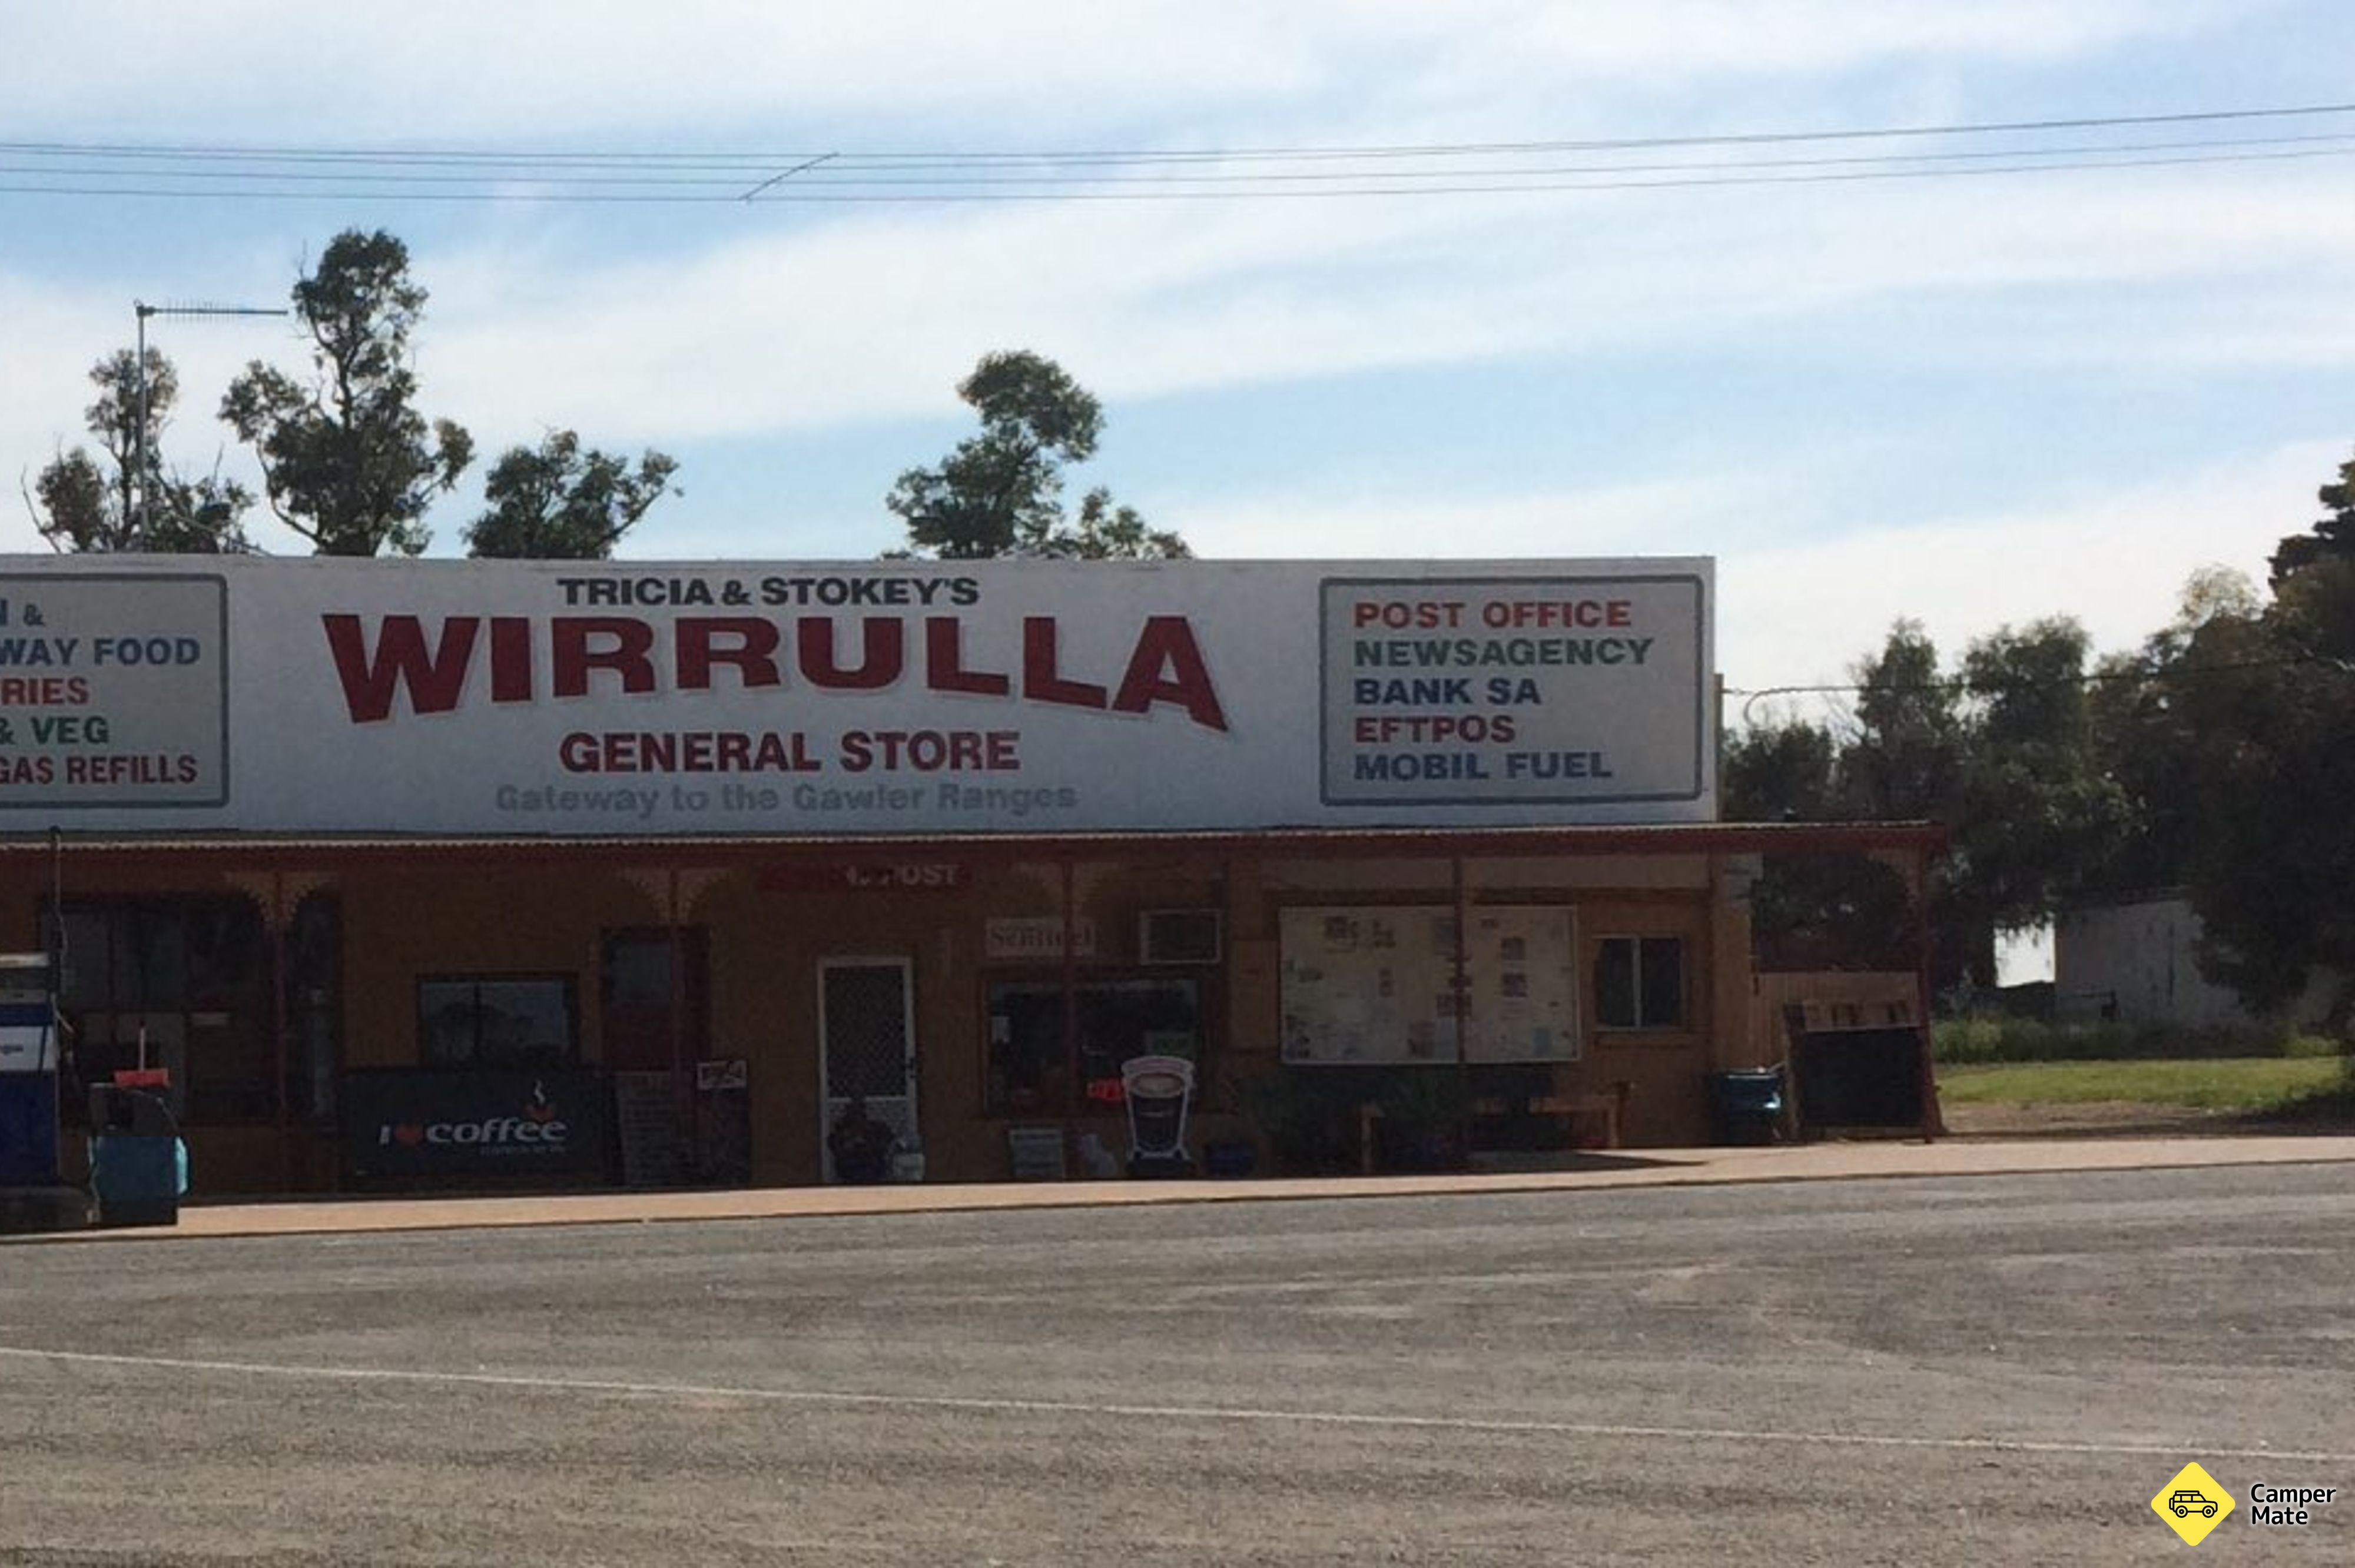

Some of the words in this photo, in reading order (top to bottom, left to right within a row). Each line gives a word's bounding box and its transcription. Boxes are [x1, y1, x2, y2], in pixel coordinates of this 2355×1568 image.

[557, 579, 714, 606] TRICIA
[722, 581, 751, 605] &
[761, 577, 979, 606] STOKEY'S
[23, 604, 44, 626] &
[1355, 602, 1464, 628] POST
[1483, 601, 1631, 628] OFFICE
[94, 638, 201, 665] FOOD
[1355, 639, 1653, 666] NEWSAGENCY
[321, 614, 1228, 732] WIRRULLA
[1355, 679, 1472, 705] BANK
[1487, 678, 1541, 705] SA
[31, 716, 110, 745] VEG
[1355, 716, 1515, 743] EFTPOS
[559, 732, 821, 773] GENERAL
[840, 732, 1020, 771] STORE
[1355, 753, 1488, 780] MOBIL
[1506, 752, 1612, 779] FUEL
[67, 756, 197, 784] REFILLS
[496, 785, 658, 818] Gateway
[671, 786, 708, 812] to
[722, 784, 779, 812] the
[793, 782, 926, 811] Gawler
[937, 783, 1079, 815] Ranges
[426, 1117, 568, 1143] coffee
